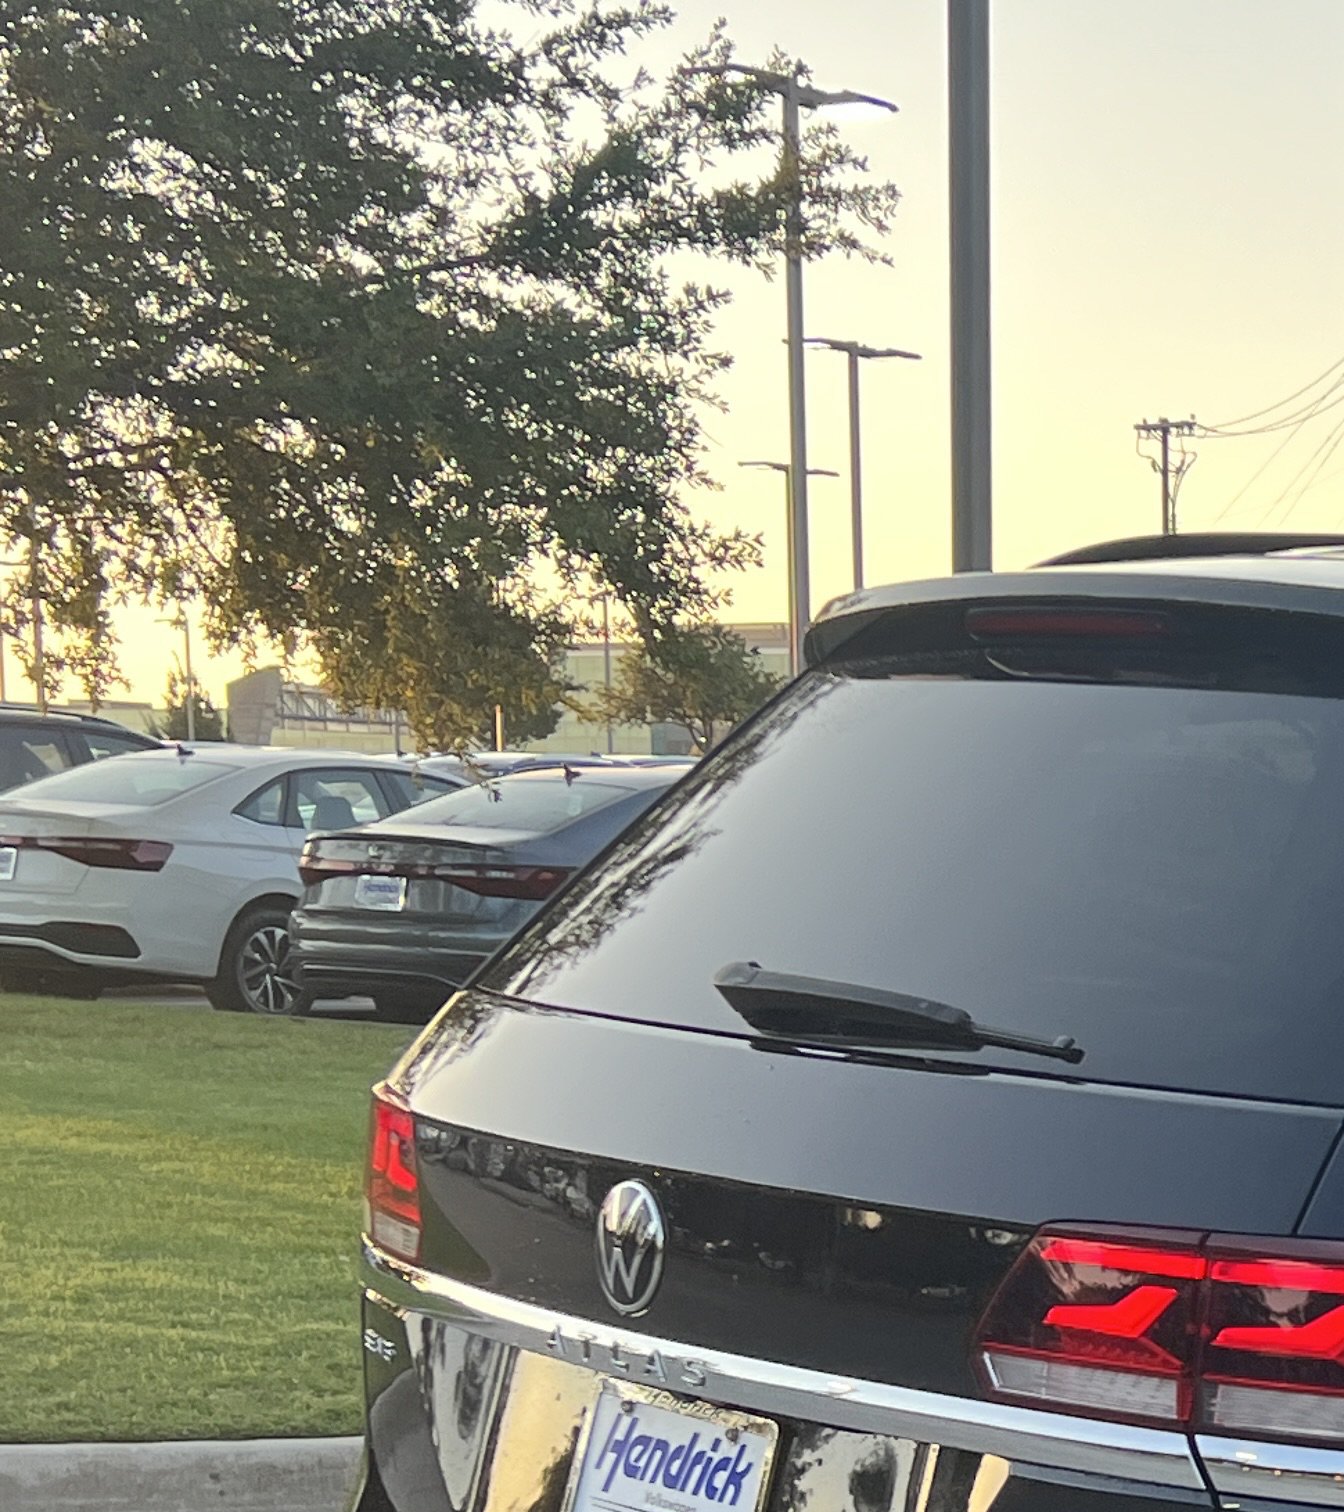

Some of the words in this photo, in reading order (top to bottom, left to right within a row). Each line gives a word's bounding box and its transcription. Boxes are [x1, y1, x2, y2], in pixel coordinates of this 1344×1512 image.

[600, 1180, 664, 1312] VW
[546, 1324, 707, 1387] ATLAS
[595, 1412, 754, 1506] Hendrick
